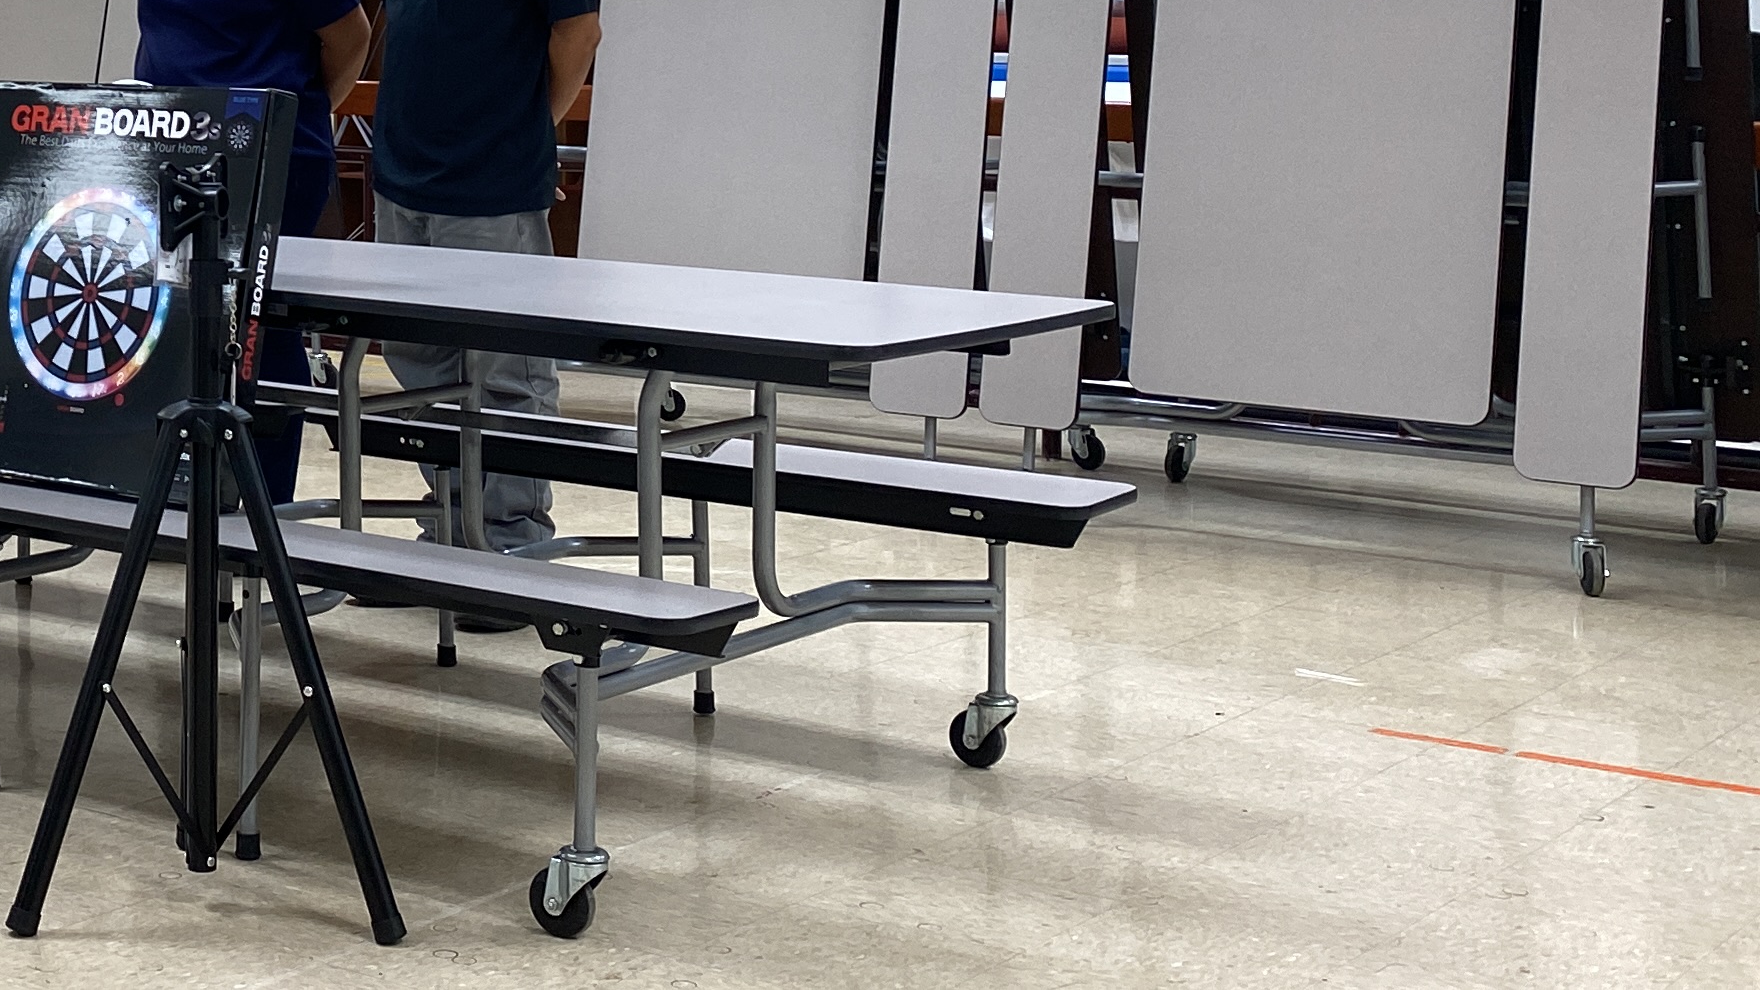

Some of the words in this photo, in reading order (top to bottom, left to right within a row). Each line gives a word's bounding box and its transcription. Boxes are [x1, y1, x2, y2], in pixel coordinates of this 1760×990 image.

[20, 133, 38, 146] The
[39, 135, 59, 147] Best
[153, 140, 176, 154] Your
[177, 142, 208, 155] Home
[116, 372, 125, 386] 2
